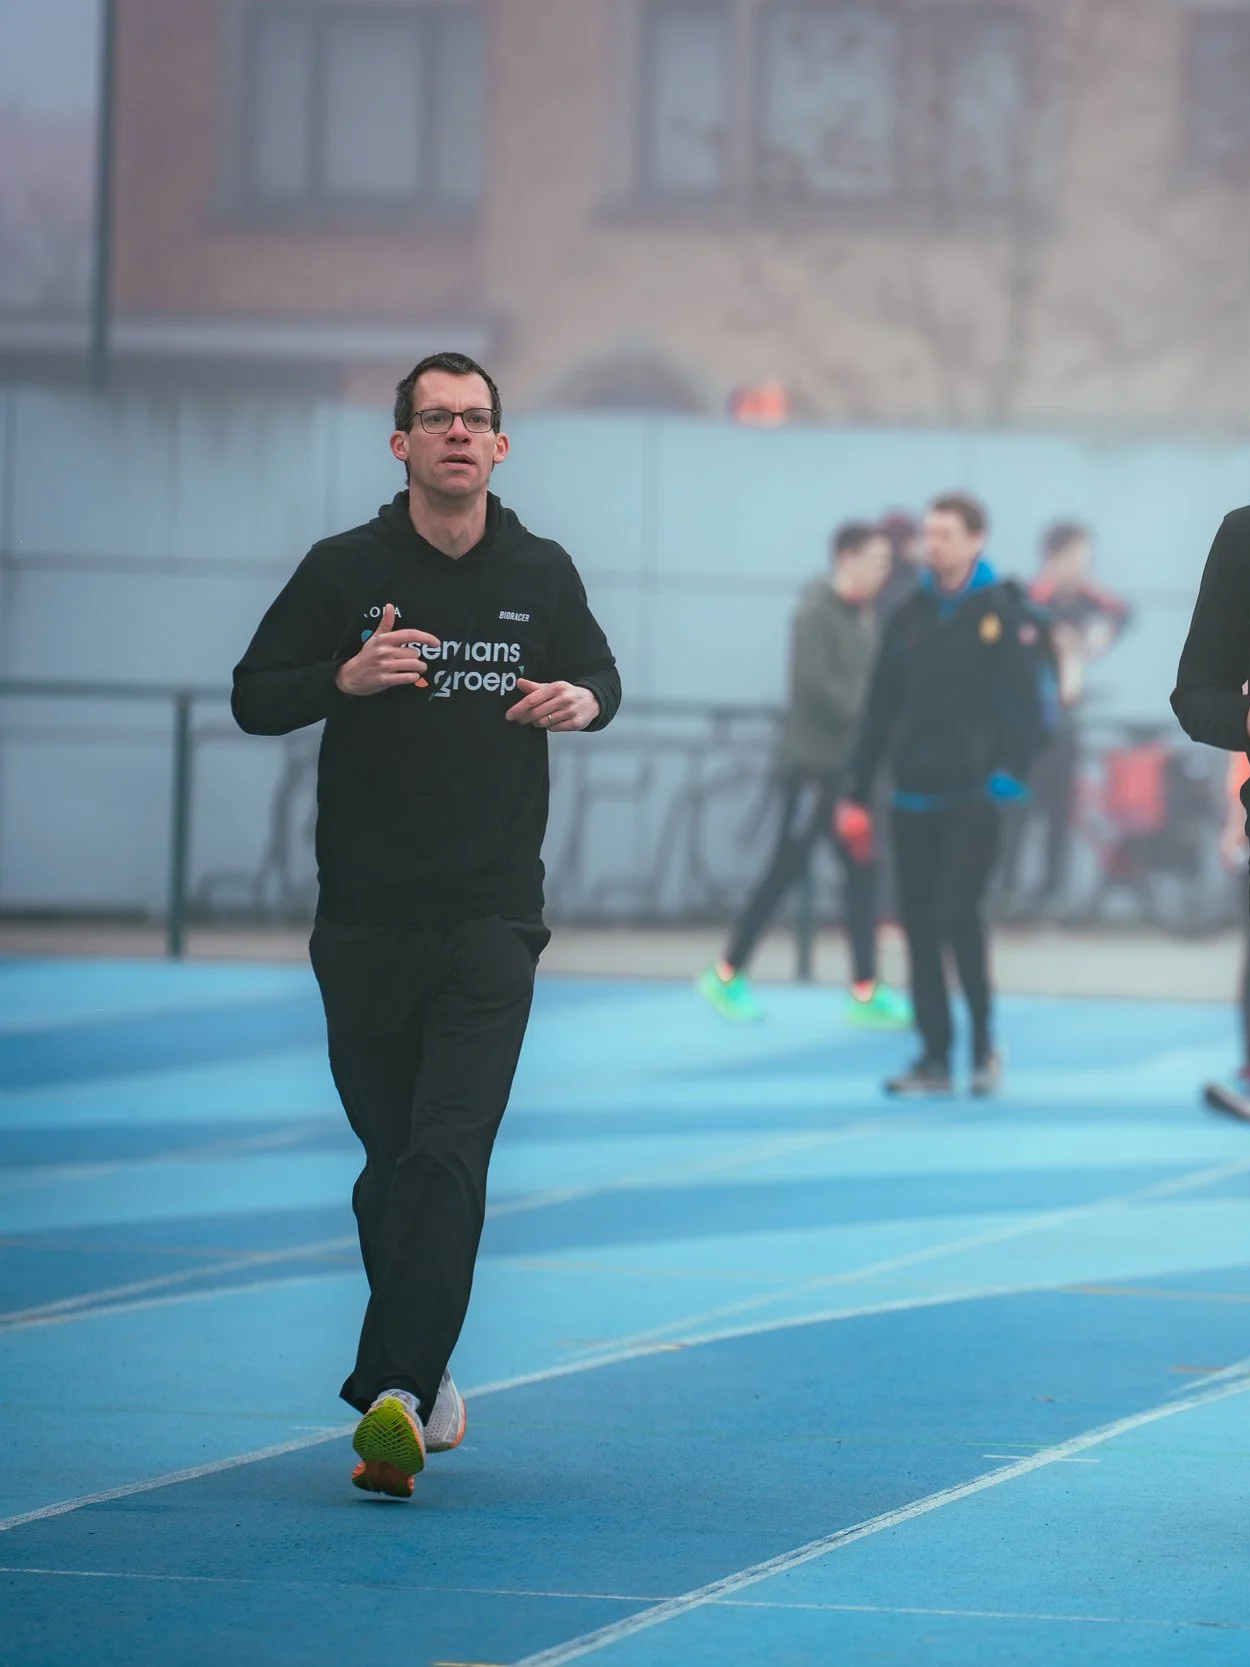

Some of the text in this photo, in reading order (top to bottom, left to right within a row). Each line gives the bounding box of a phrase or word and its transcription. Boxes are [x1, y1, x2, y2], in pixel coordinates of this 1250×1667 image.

[363, 606, 402, 618] OA
[499, 610, 530, 622] BIORACER
[400, 641, 521, 663] semans
[434, 670, 517, 698] groep
